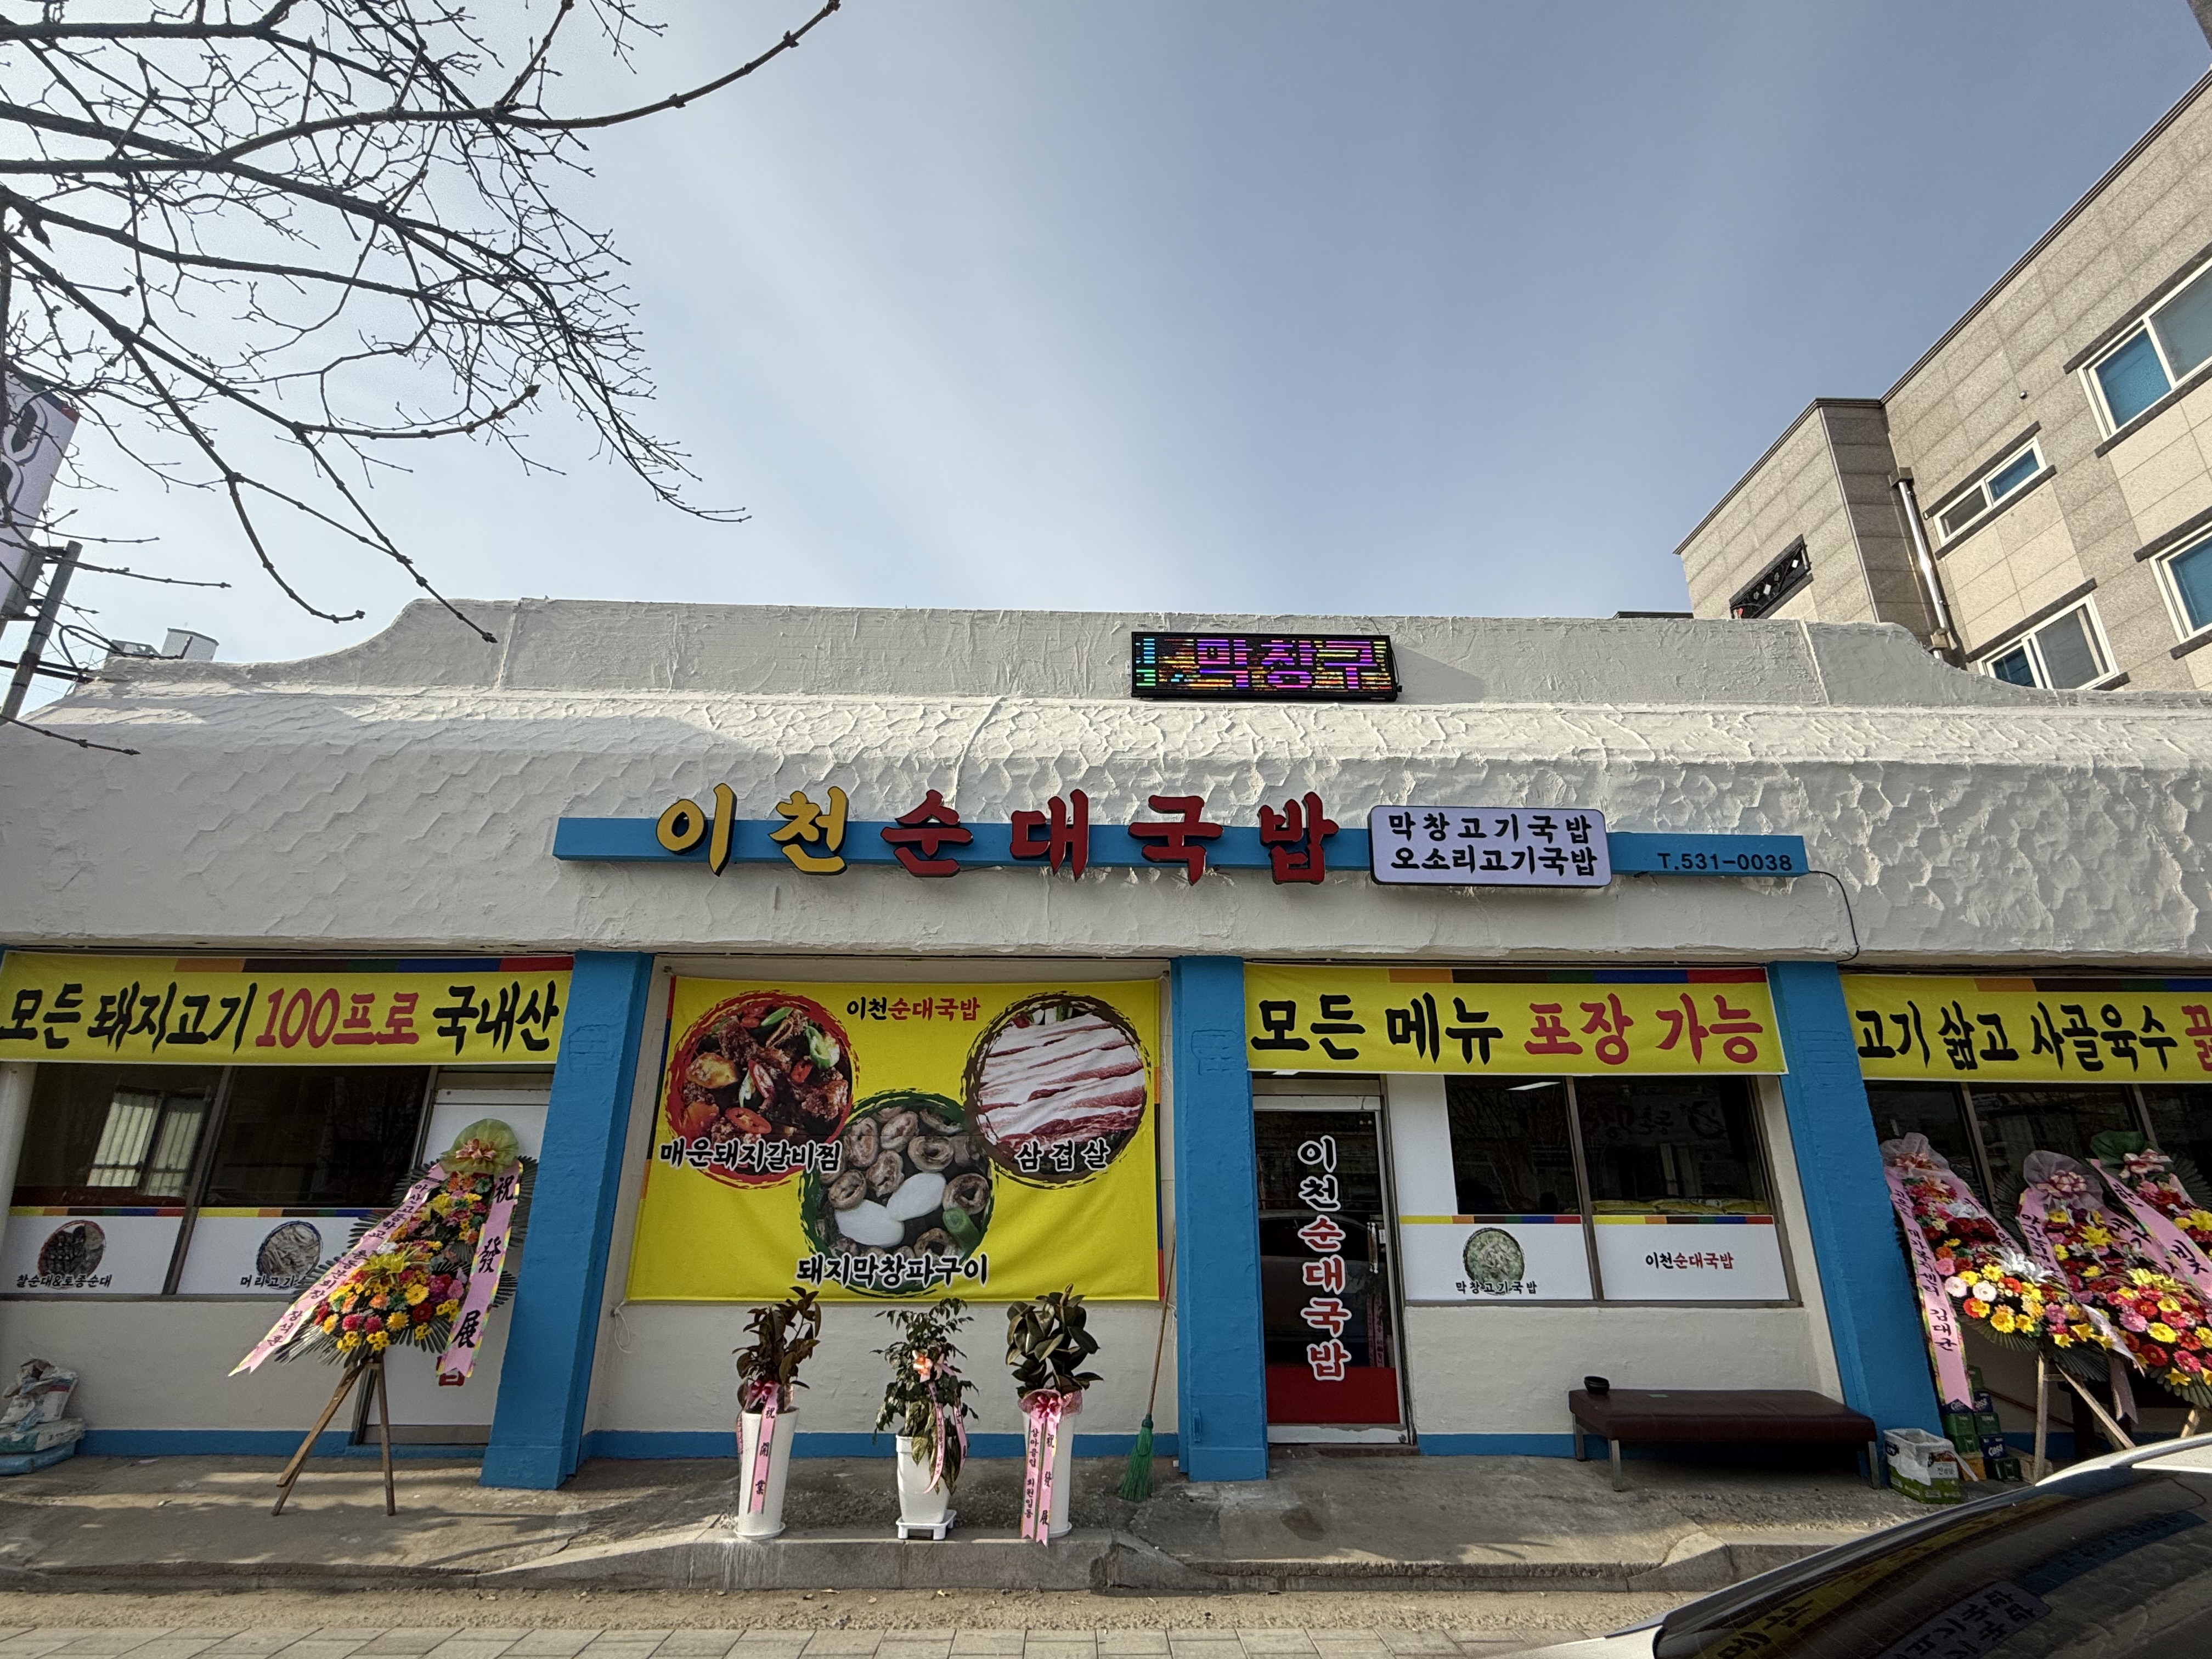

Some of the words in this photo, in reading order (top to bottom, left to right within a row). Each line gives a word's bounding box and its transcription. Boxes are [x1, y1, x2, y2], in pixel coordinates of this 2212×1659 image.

[1390, 813, 1593, 844] 막창고기국밥
[1391, 847, 1597, 877] 오소리고기국밥
[1658, 853, 1793, 871] T.531-0038
[0, 984, 84, 1049] 모든
[87, 981, 258, 1053] 돼지고기
[255, 988, 420, 1049] 100프로
[432, 980, 560, 1056] 국내산
[846, 995, 982, 1022] 이천순대국밥
[1251, 995, 1364, 1061] 모든
[1385, 991, 1504, 1065] 메뉴
[1524, 994, 1634, 1065] 포장
[1655, 993, 1764, 1065] 가능
[1855, 1000, 1931, 1068] 고기
[1938, 1000, 2018, 1071] 삶고
[2031, 1003, 2178, 1073] 사골육수
[659, 1139, 843, 1174] 매운돼지갈비찜
[1017, 1138, 1111, 1174] 삼겹살
[797, 1253, 990, 1289] 돼지막창파구이
[1645, 1253, 1734, 1271] 이천순대국밥
[1454, 1279, 1538, 1296] 막창고기국밥
